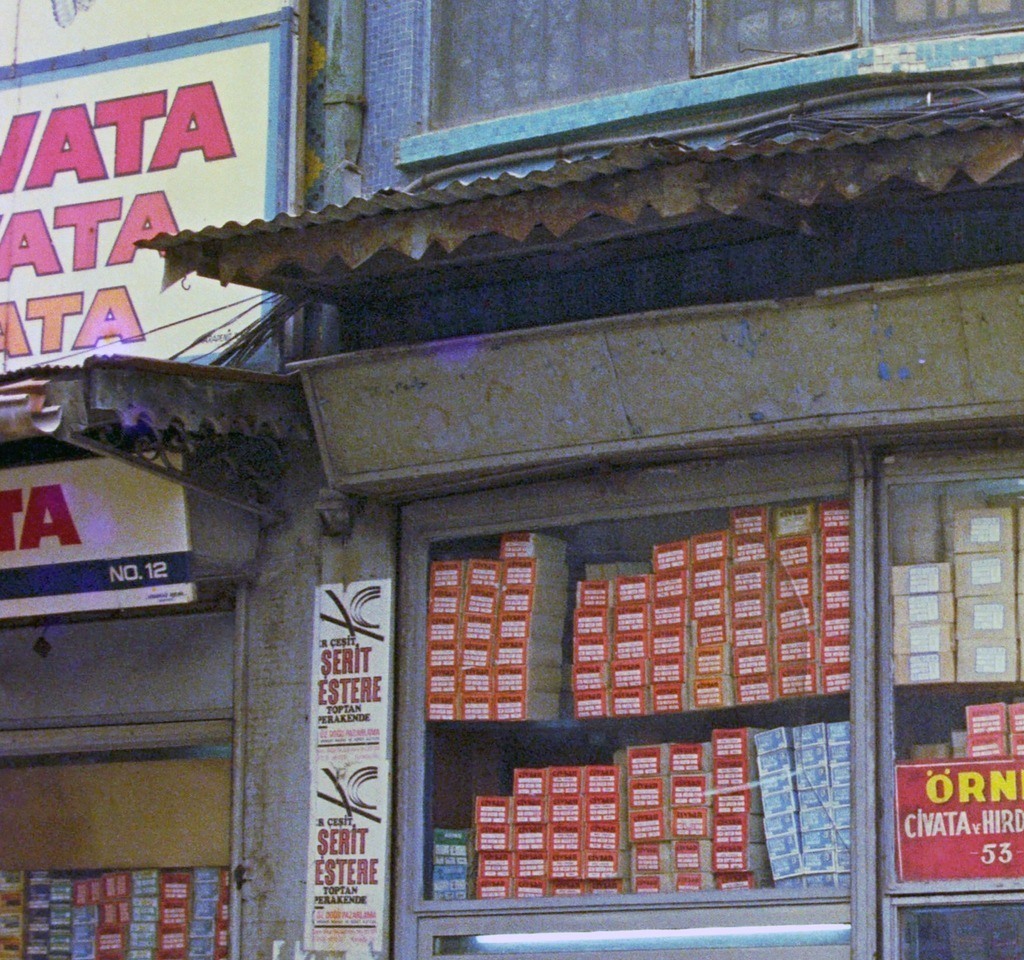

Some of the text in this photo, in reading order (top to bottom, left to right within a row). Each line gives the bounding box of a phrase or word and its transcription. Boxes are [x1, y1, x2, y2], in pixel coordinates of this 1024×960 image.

[145, 561, 168, 579] 12
[326, 705, 362, 714] TOPTAN
[904, 808, 971, 838] CİVATA
[323, 886, 358, 896] TOPTAN
